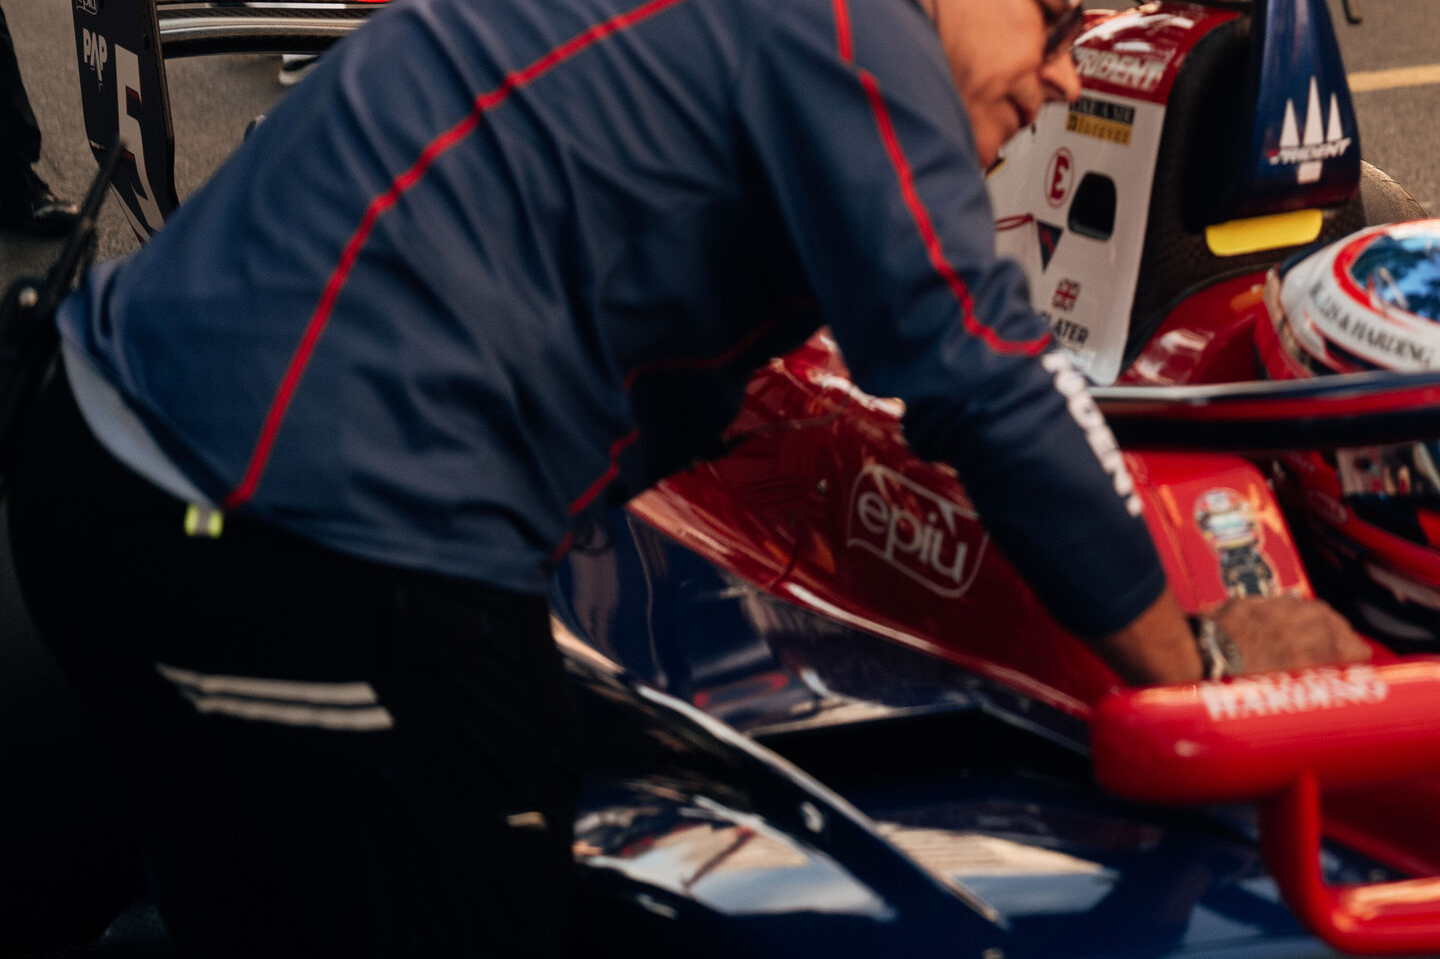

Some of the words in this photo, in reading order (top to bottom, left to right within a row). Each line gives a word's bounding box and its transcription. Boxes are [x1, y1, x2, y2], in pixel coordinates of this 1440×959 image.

[83, 28, 108, 83] PAP
[1075, 46, 1166, 91] RIDENT
[1043, 312, 1089, 344] ATER
